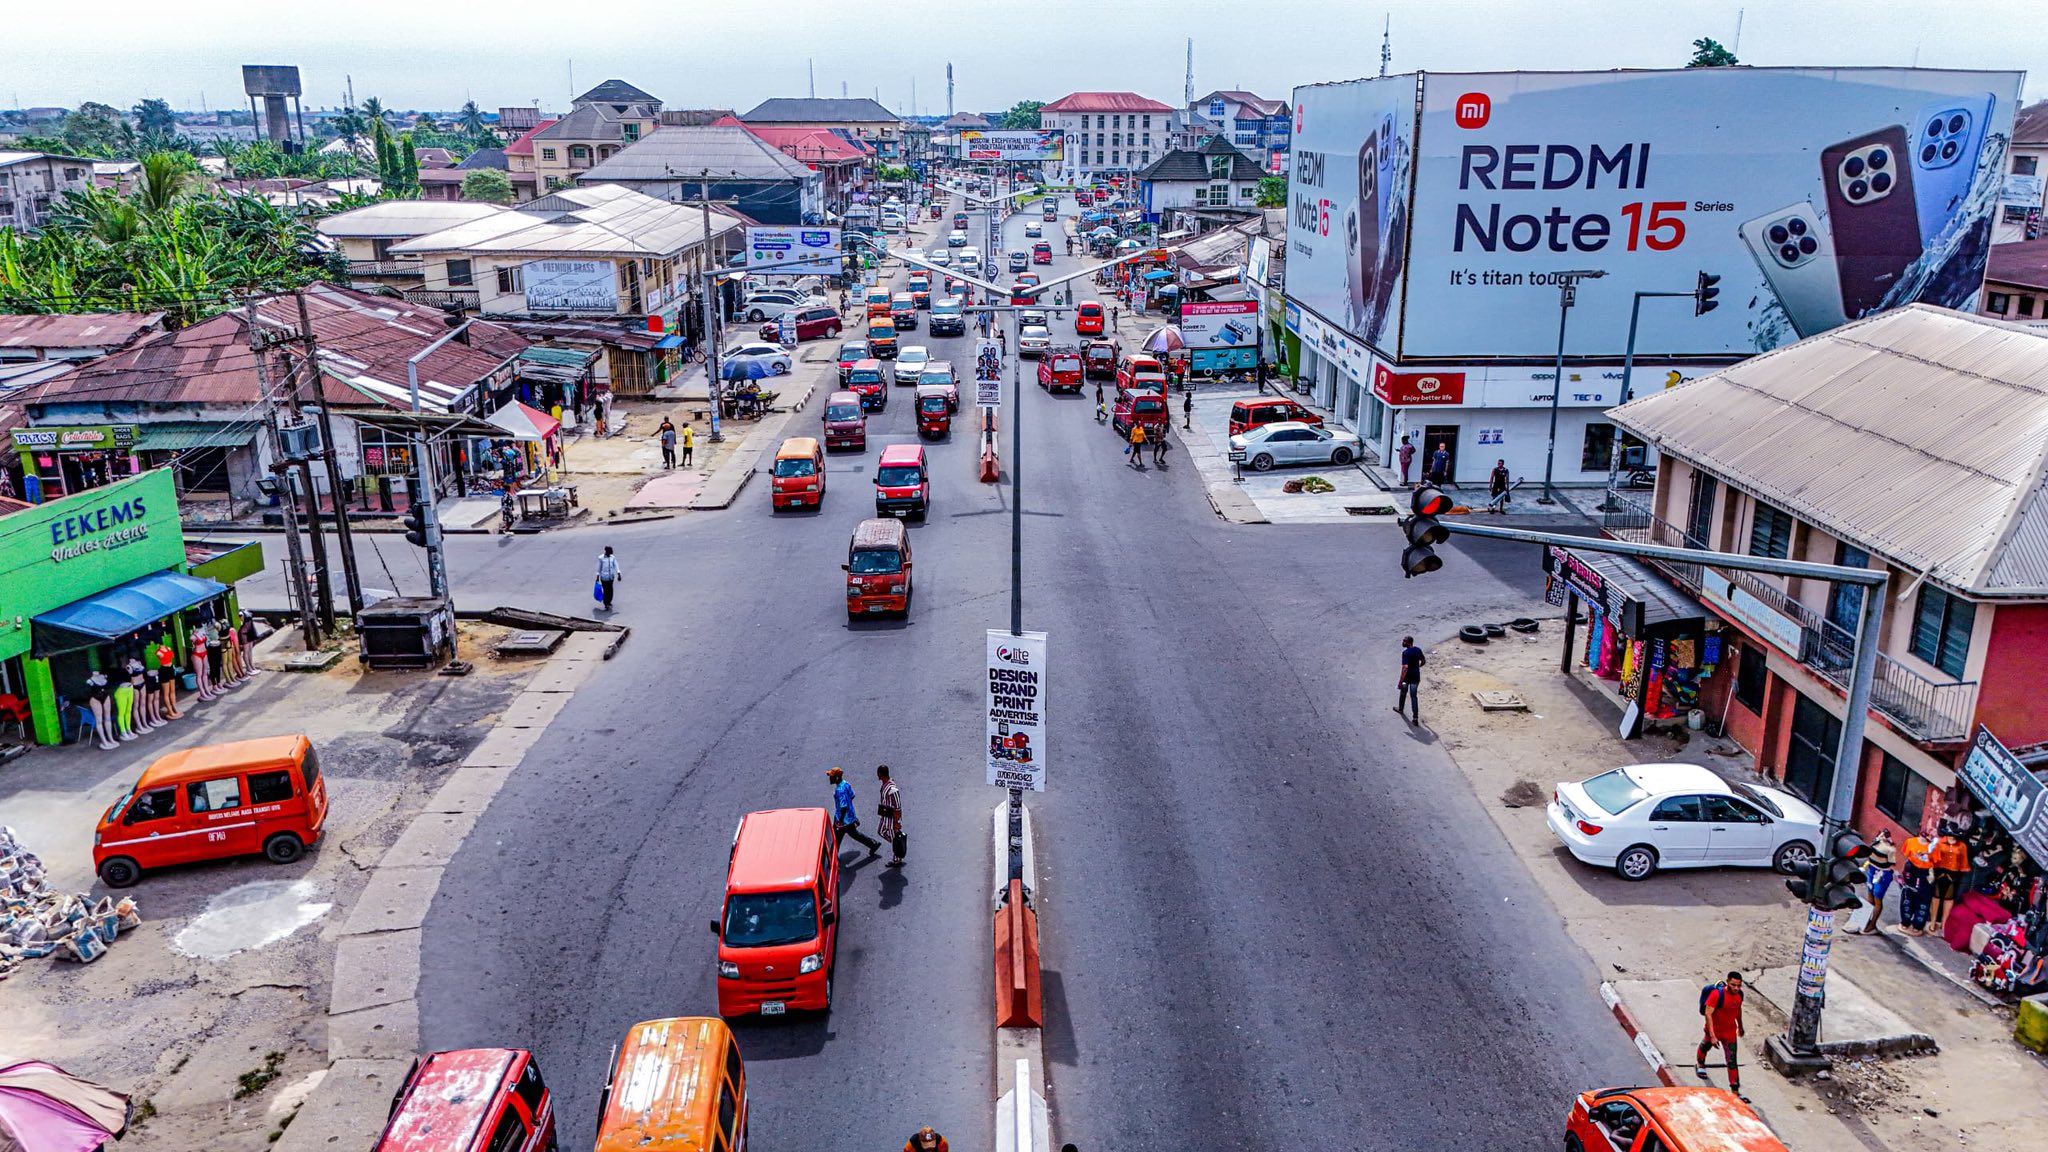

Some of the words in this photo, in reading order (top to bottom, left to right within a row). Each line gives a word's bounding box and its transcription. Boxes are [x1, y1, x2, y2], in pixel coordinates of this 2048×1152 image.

[1296, 150, 1326, 188] REDMI
[1459, 143, 1651, 190] REDMI
[1294, 192, 1318, 233] Note
[1318, 199, 1330, 238] 15
[1453, 203, 1611, 252] Note
[1621, 201, 1688, 251] 15
[1694, 201, 1734, 212] Series
[543, 262, 572, 273] PREMIUM
[574, 263, 595, 273] BRASS
[1450, 269, 1477, 286] It's
[1482, 269, 1523, 286] titan
[1421, 380, 1437, 389] itel
[15, 433, 57, 444] TRACY
[50, 496, 146, 545] EEKEMS
[51, 540, 100, 563] Undies
[103, 523, 147, 549] Arena
[989, 667, 1038, 684] DESIGN
[990, 681, 1037, 697] BRAND
[993, 695, 1035, 711] PRINT
[989, 708, 1039, 721] ADVERTISE
